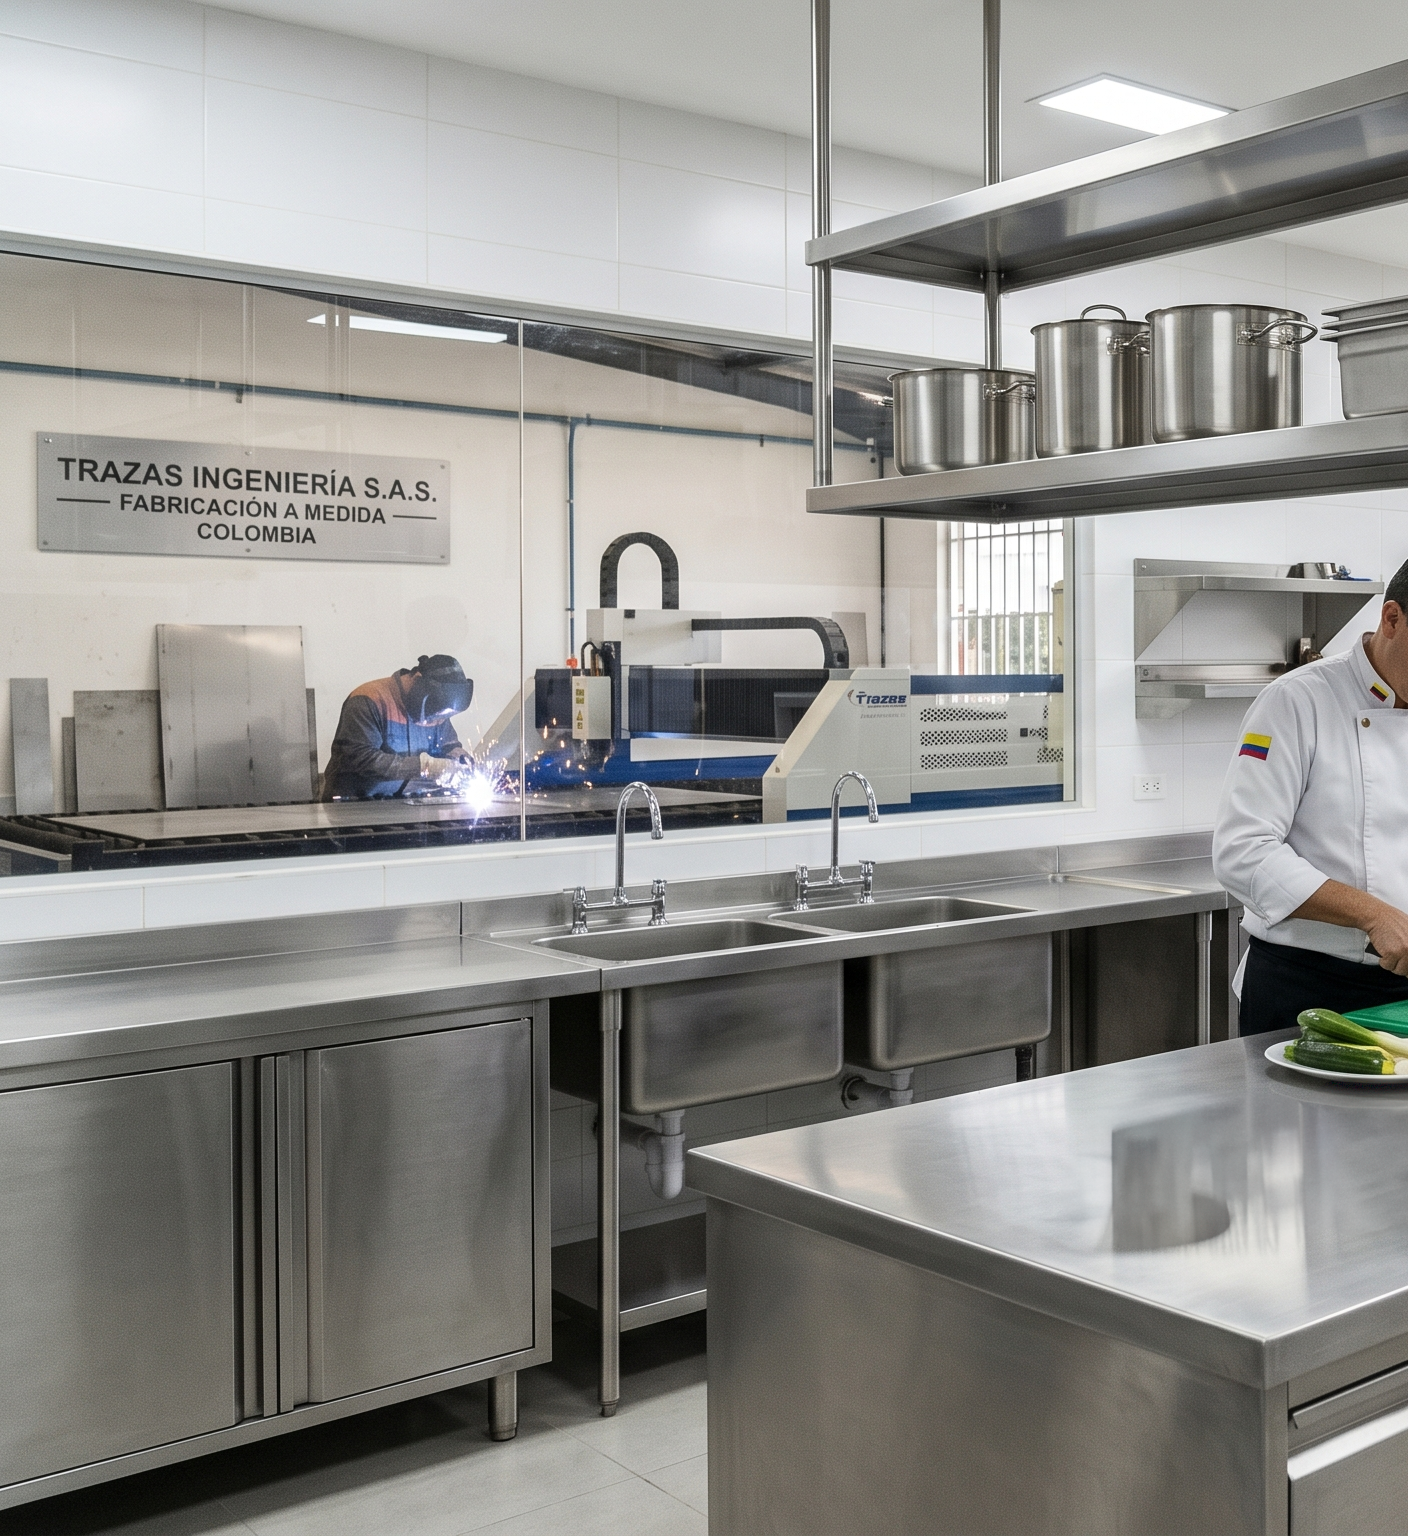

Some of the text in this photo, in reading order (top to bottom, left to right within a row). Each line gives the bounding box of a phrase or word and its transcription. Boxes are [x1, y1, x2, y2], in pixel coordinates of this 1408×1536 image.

[57, 457, 437, 502] TRAZAS INGENIERÍA S.A.S.
[120, 493, 386, 524] FABRICACIÓN A MEDIDA
[197, 522, 317, 544] COLOMBIA
